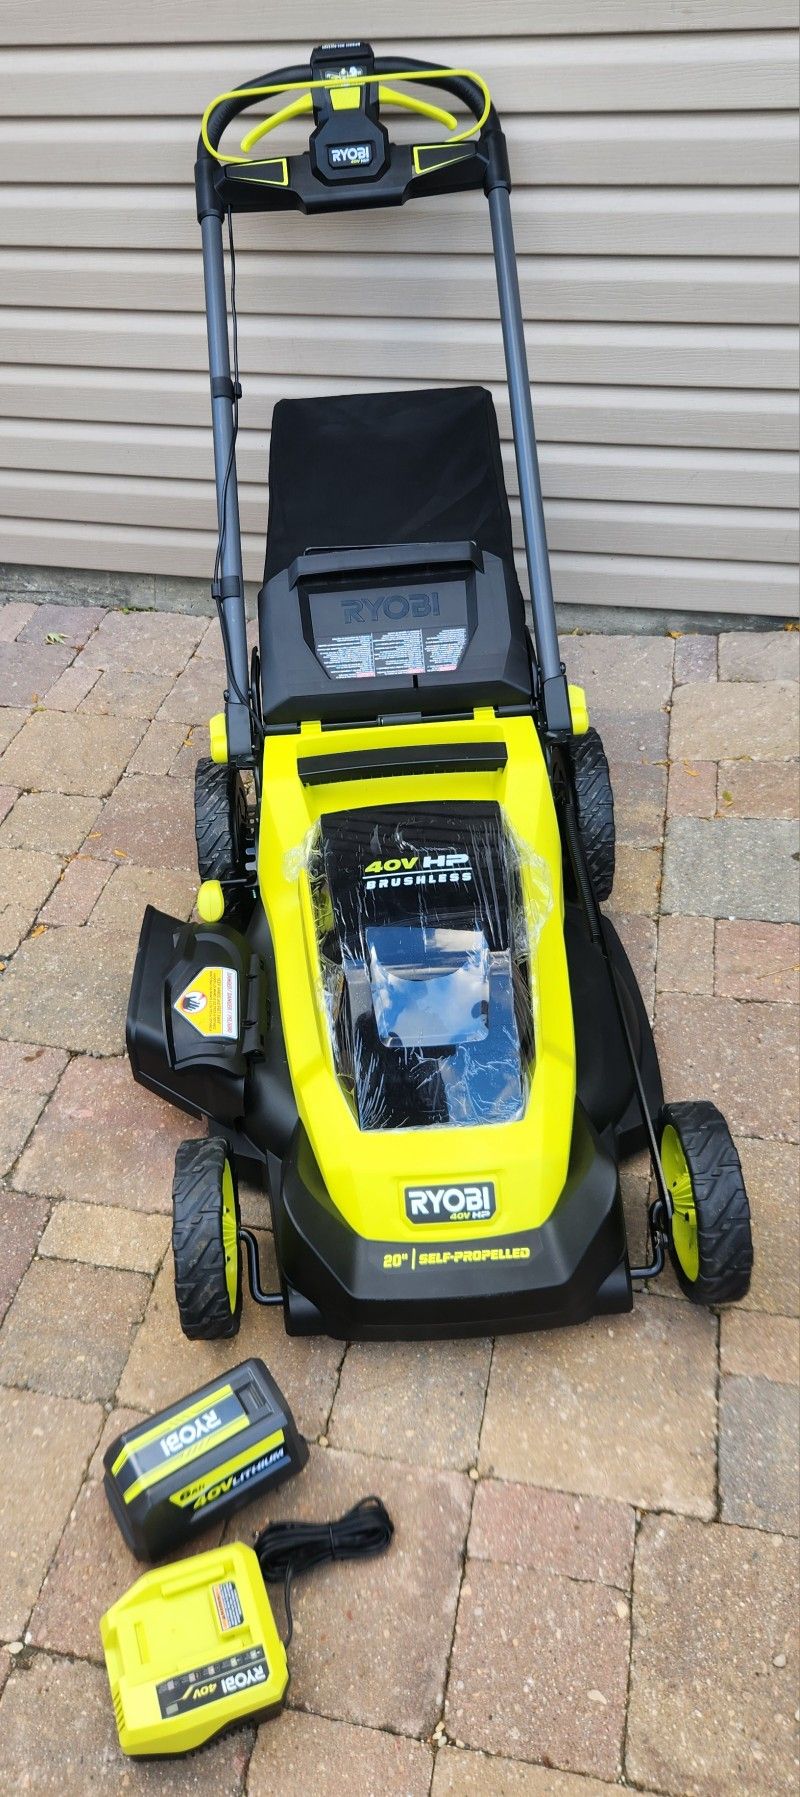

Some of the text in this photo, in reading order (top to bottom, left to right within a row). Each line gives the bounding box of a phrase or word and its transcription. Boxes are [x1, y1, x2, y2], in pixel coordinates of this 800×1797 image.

[331, 146, 370, 162] RYOBI
[340, 592, 441, 625] RYOBI
[364, 853, 469, 873] 40V HP
[366, 872, 472, 890] BRUSHLESS
[408, 1186, 491, 1215] RYOBI
[449, 1210, 491, 1220] 40V HP
[383, 1247, 531, 1269] 20" SELF-PROPELLED
[160, 1409, 222, 1456] RYOBI
[221, 1665, 266, 1694] RYOBI
[193, 1683, 217, 1700] 40V
